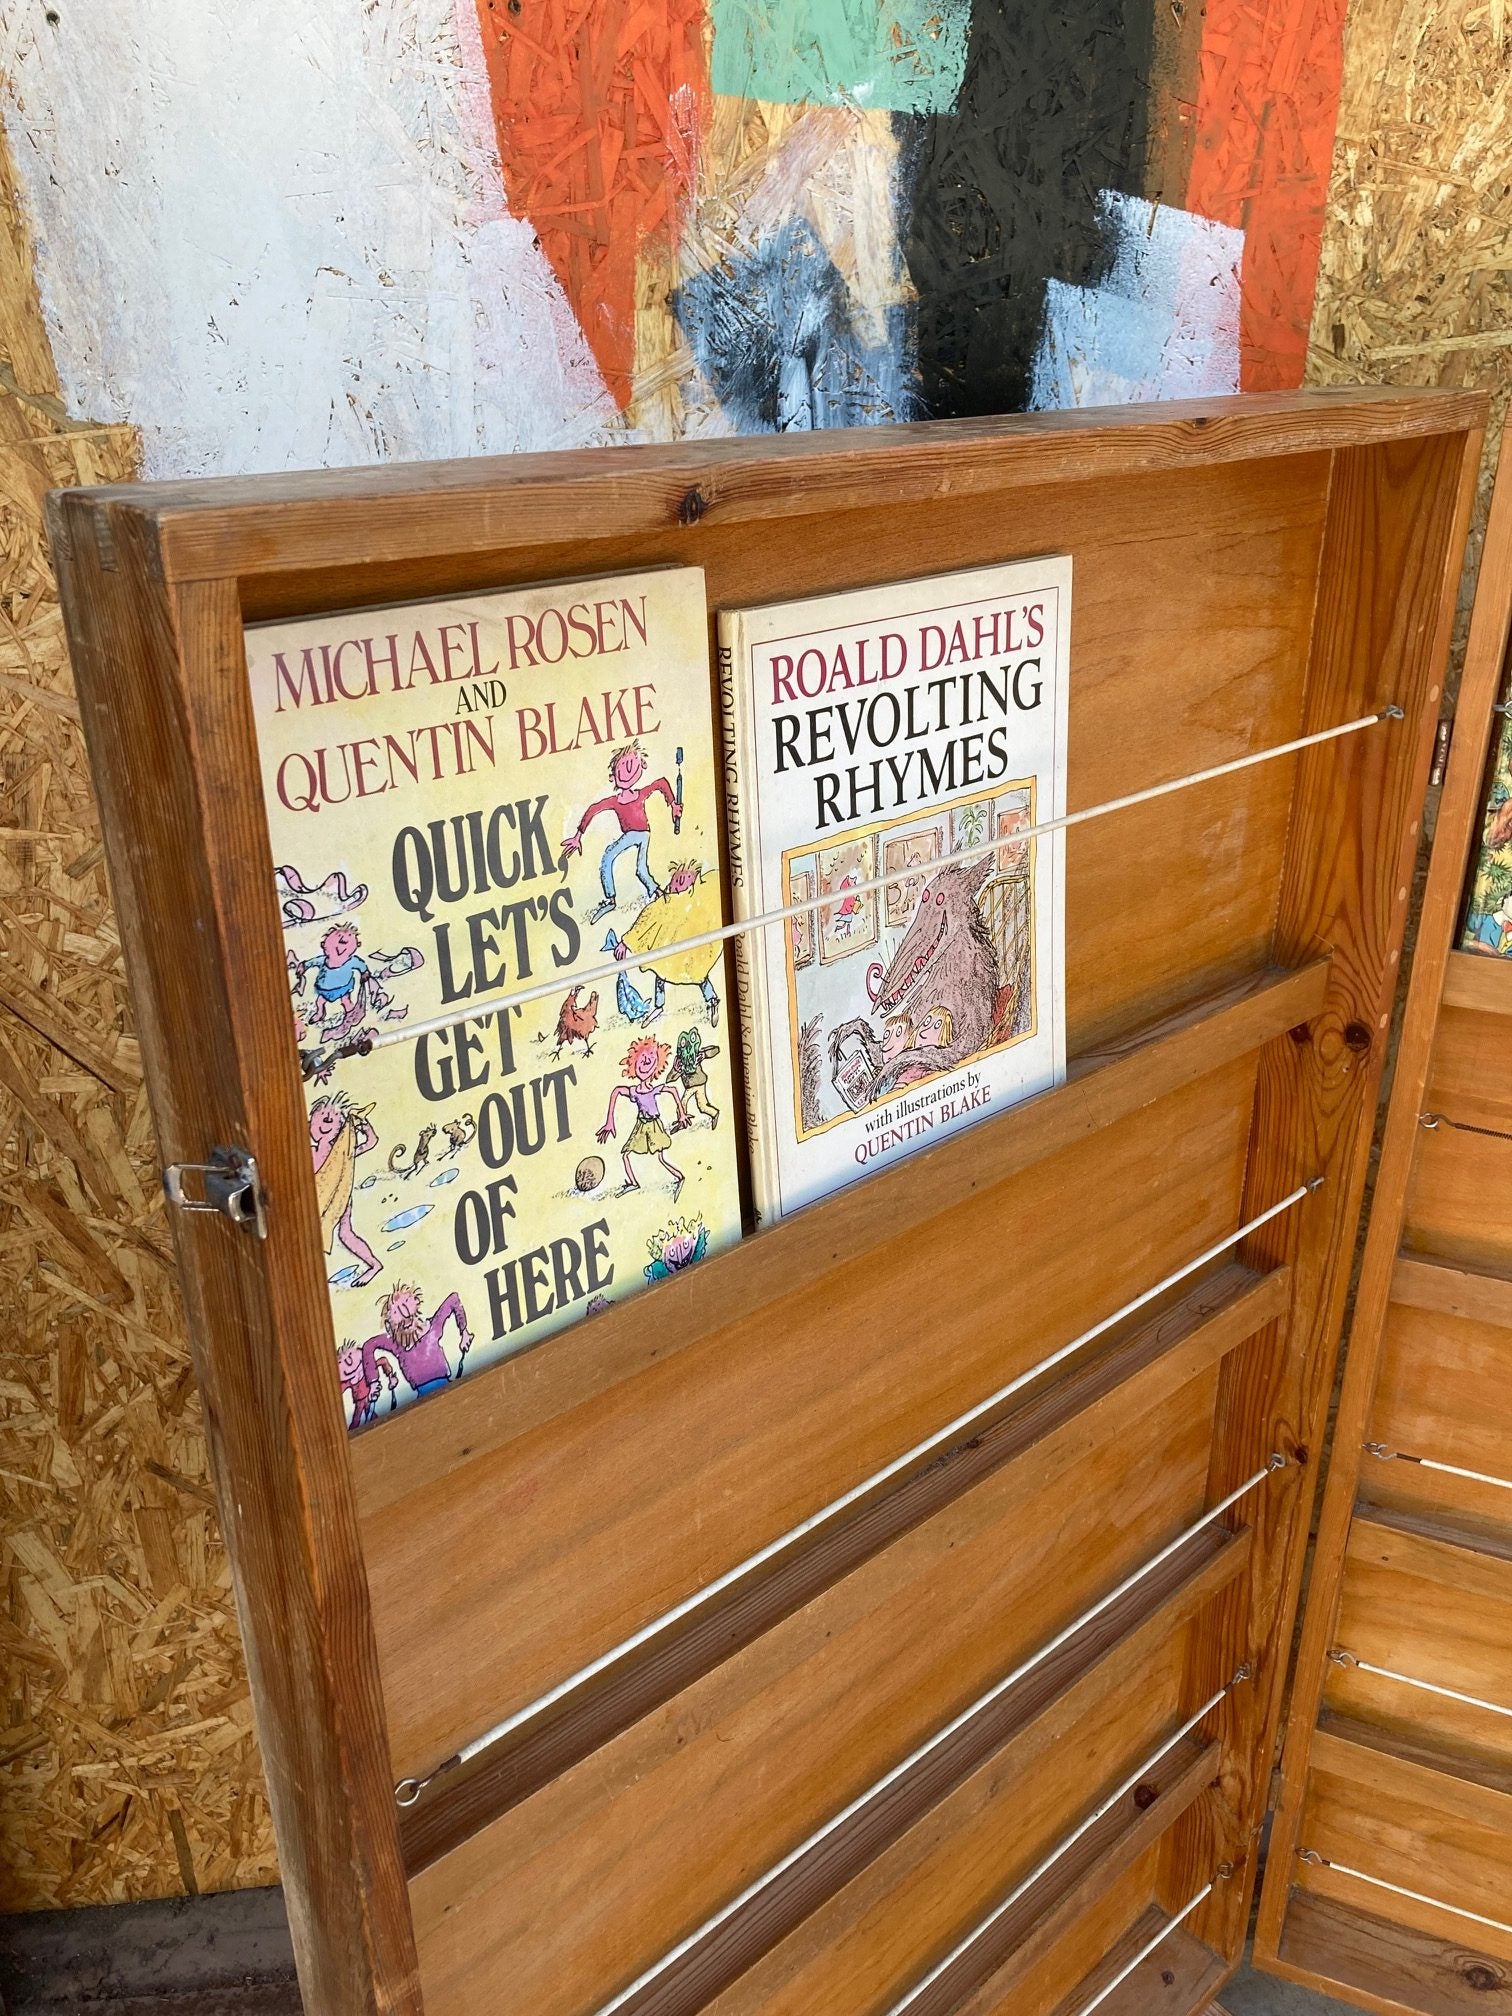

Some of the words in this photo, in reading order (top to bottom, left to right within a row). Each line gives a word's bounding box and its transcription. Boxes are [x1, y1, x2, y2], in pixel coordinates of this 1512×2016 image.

[272, 622, 500, 712] MICHAEL
[505, 596, 648, 670] ROSEN
[455, 680, 507, 715] AND
[769, 633, 907, 705] ROALD
[918, 604, 1044, 671] DAHL'S
[276, 716, 497, 813] QUENTIN
[518, 683, 661, 761] BLAKE
[771, 657, 1043, 774] REVOLTING
[813, 726, 1008, 830] RHYMES
[392, 794, 569, 922] QUICK,
[433, 888, 581, 1005] LET'S
[414, 1004, 523, 1102] GET
[865, 1109, 892, 1134] with
[896, 1079, 966, 1120] illustrations
[968, 1071, 981, 1089] by
[478, 1065, 578, 1169] OUT
[854, 1111, 934, 1165] QUENTIN
[940, 1085, 991, 1124] BLAKE
[454, 1174, 518, 1265] OF
[484, 1217, 615, 1341] HERE
